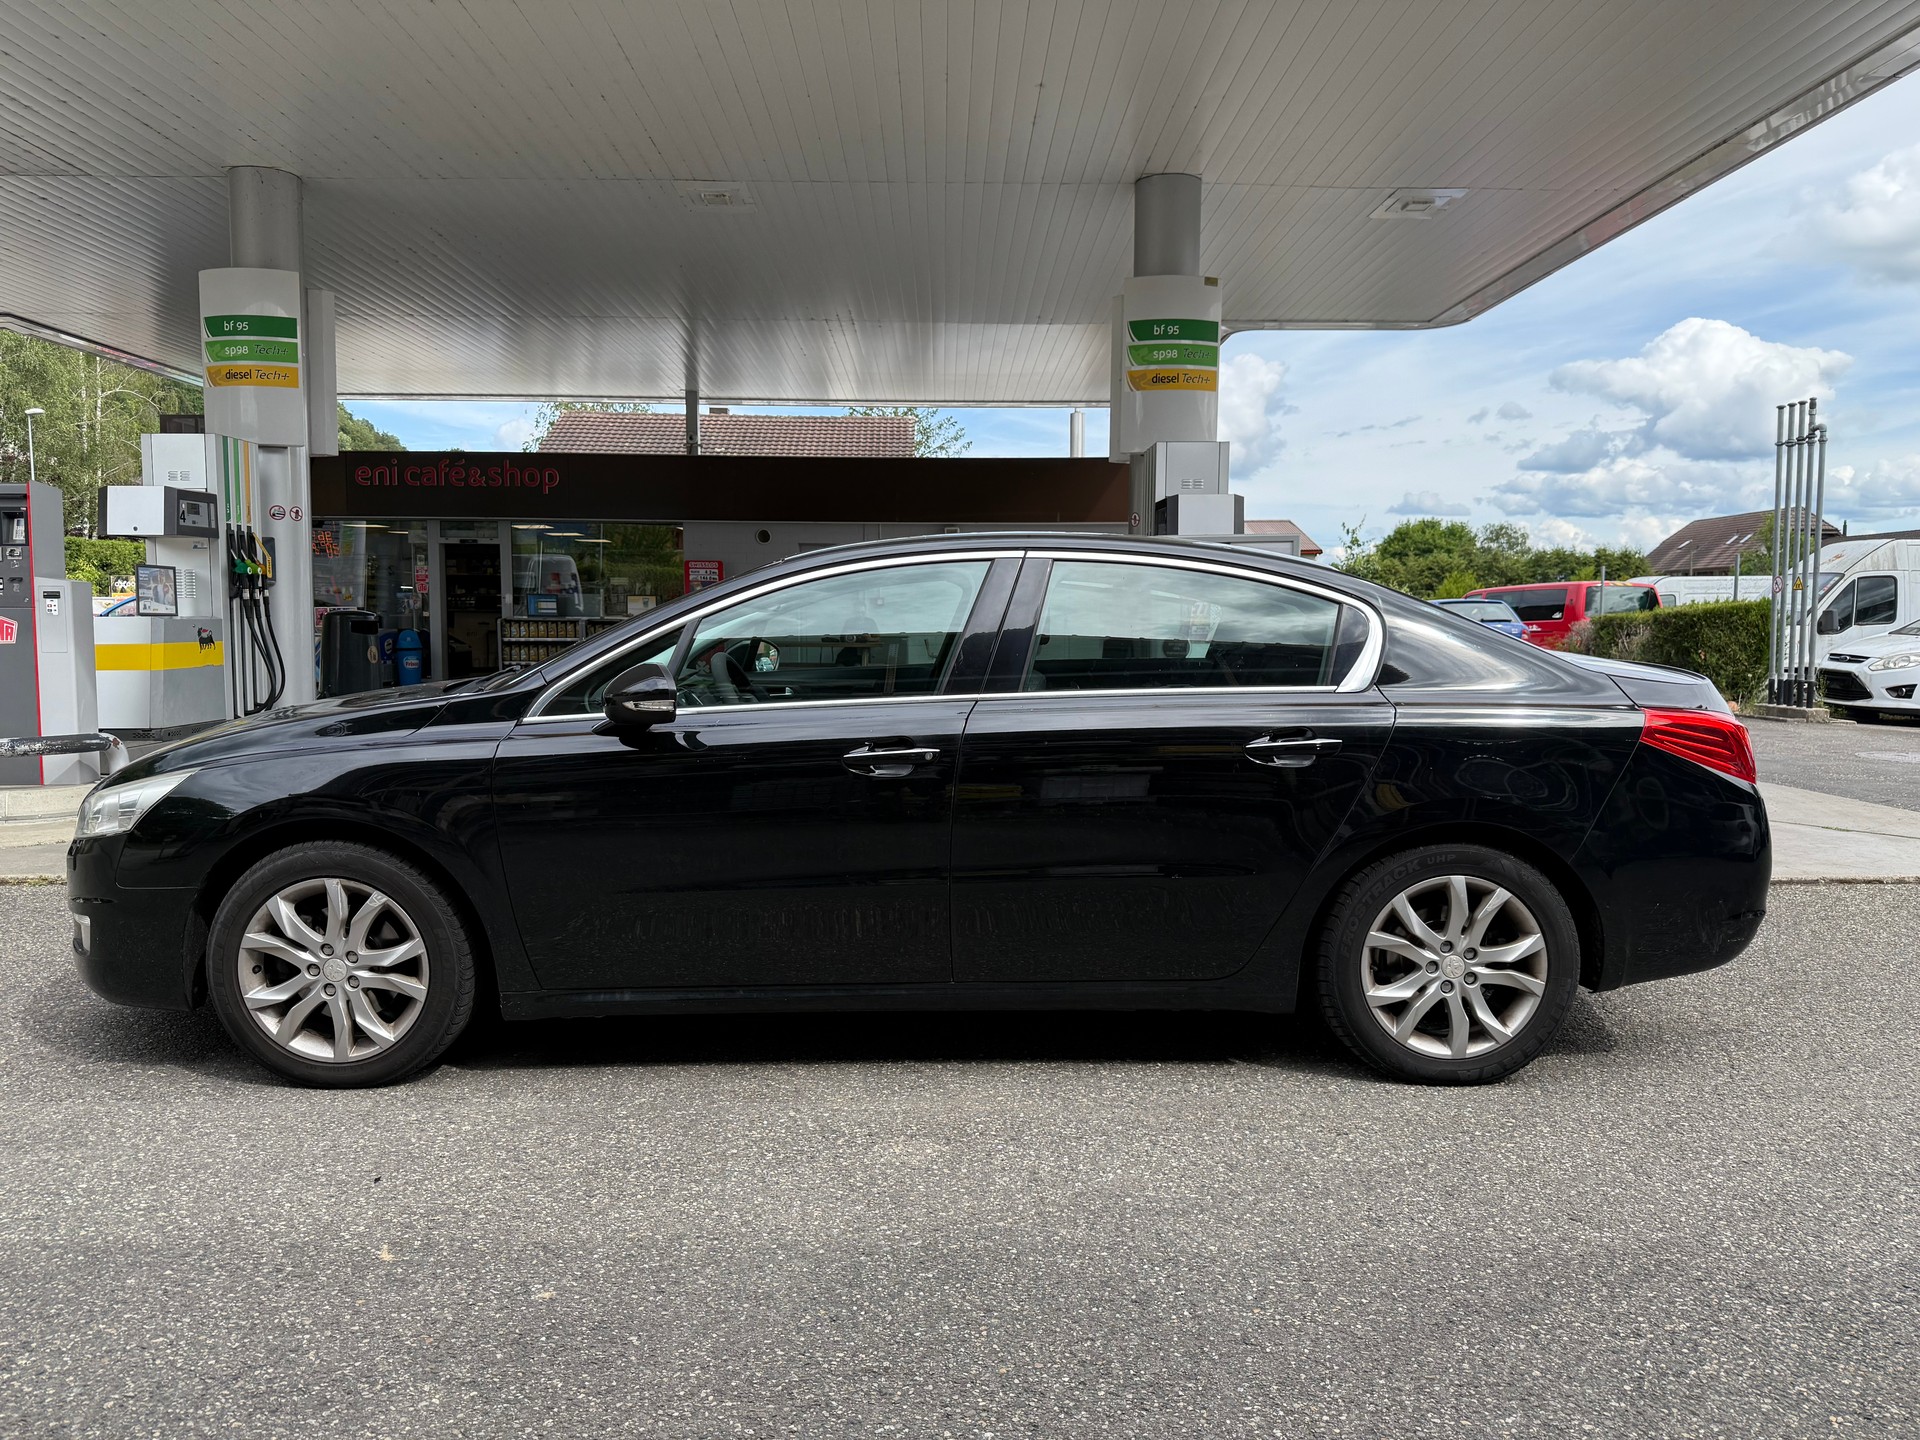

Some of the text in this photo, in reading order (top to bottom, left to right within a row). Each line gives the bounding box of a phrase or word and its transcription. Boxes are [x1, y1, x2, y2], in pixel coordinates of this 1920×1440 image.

[223, 320, 249, 331] bf 95
[1153, 324, 1180, 335] bf 95
[224, 344, 289, 357] sp98 Tech+
[1153, 348, 1212, 361] sp98 Tech+
[225, 368, 290, 381] diesel Tech+
[1151, 372, 1211, 384] diesel Tech+
[354, 458, 398, 486] eni
[180, 509, 187, 523] 4
[1426, 853, 1457, 865] UHP
[1339, 859, 1424, 957] FROSTRACK
